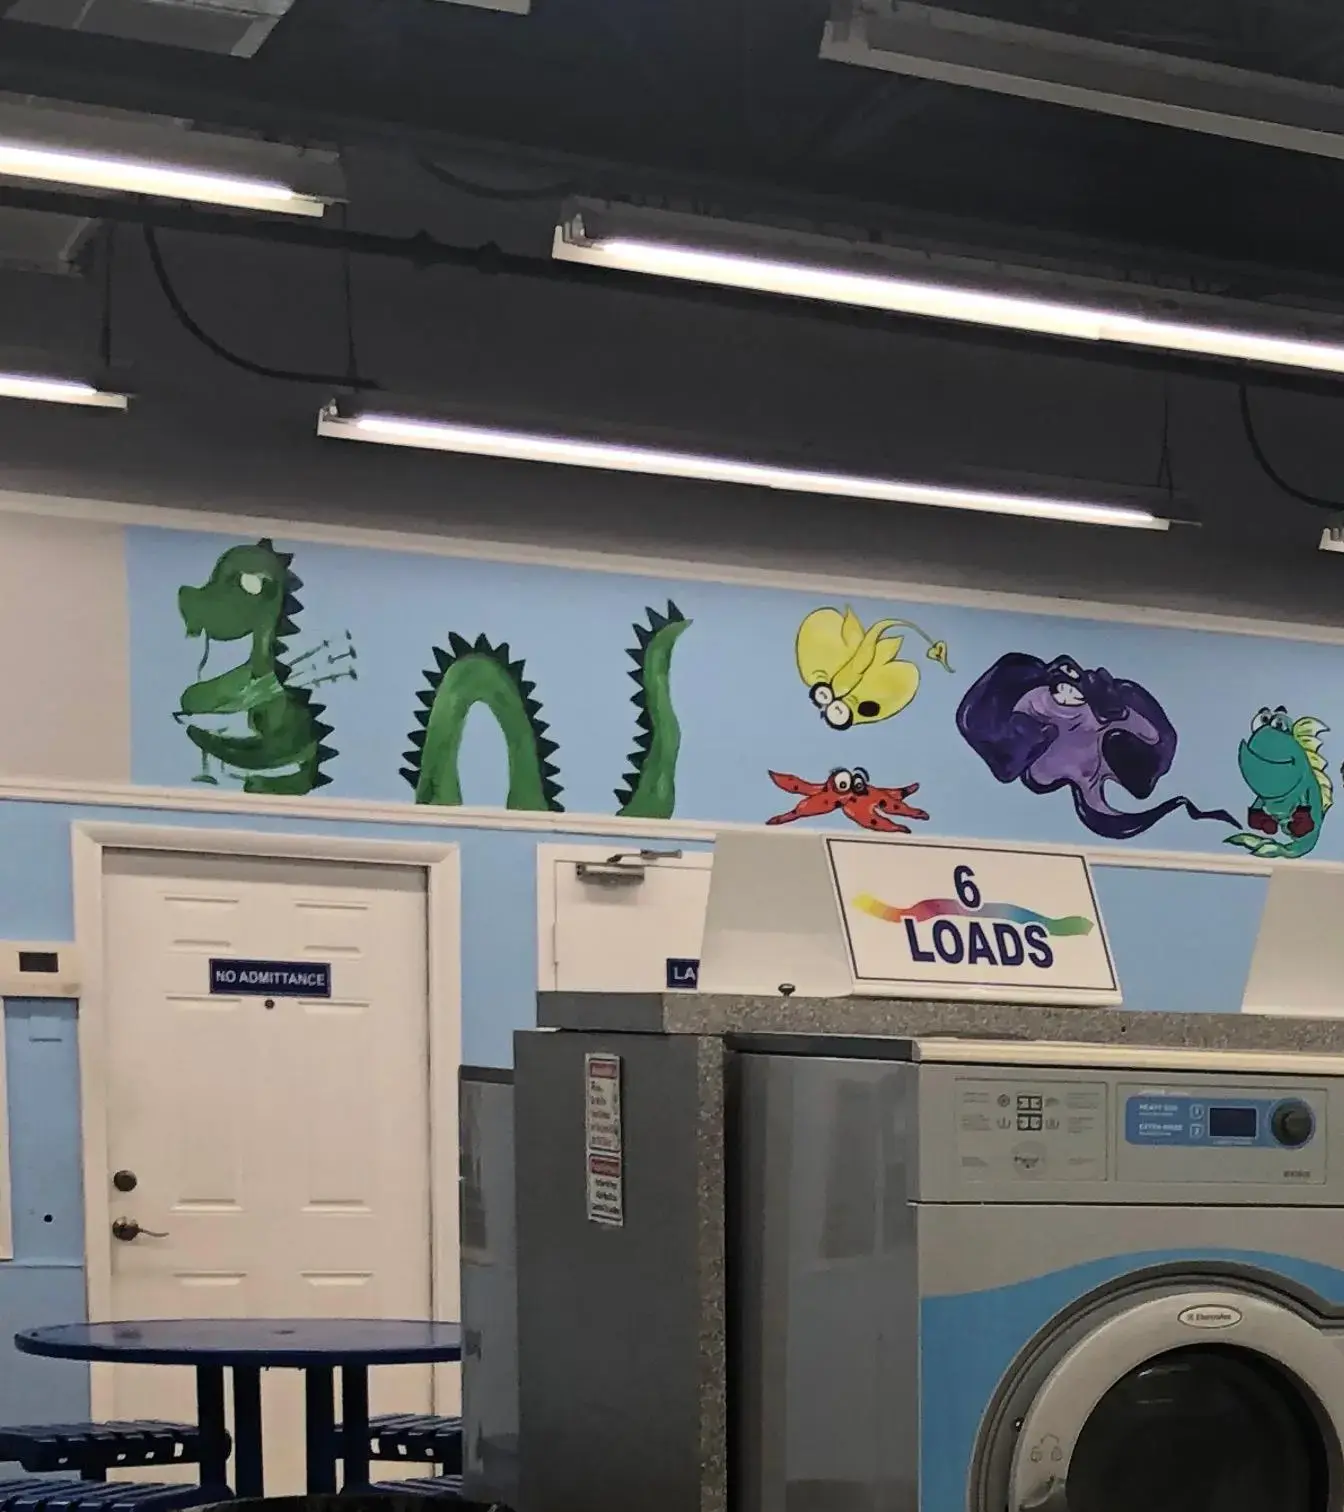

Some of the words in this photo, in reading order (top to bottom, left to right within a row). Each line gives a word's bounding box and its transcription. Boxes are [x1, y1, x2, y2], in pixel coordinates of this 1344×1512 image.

[954, 865, 980, 908] 6
[904, 918, 1054, 968] LOADS
[216, 970, 236, 983] NO
[239, 971, 325, 986] ADMITTANCE
